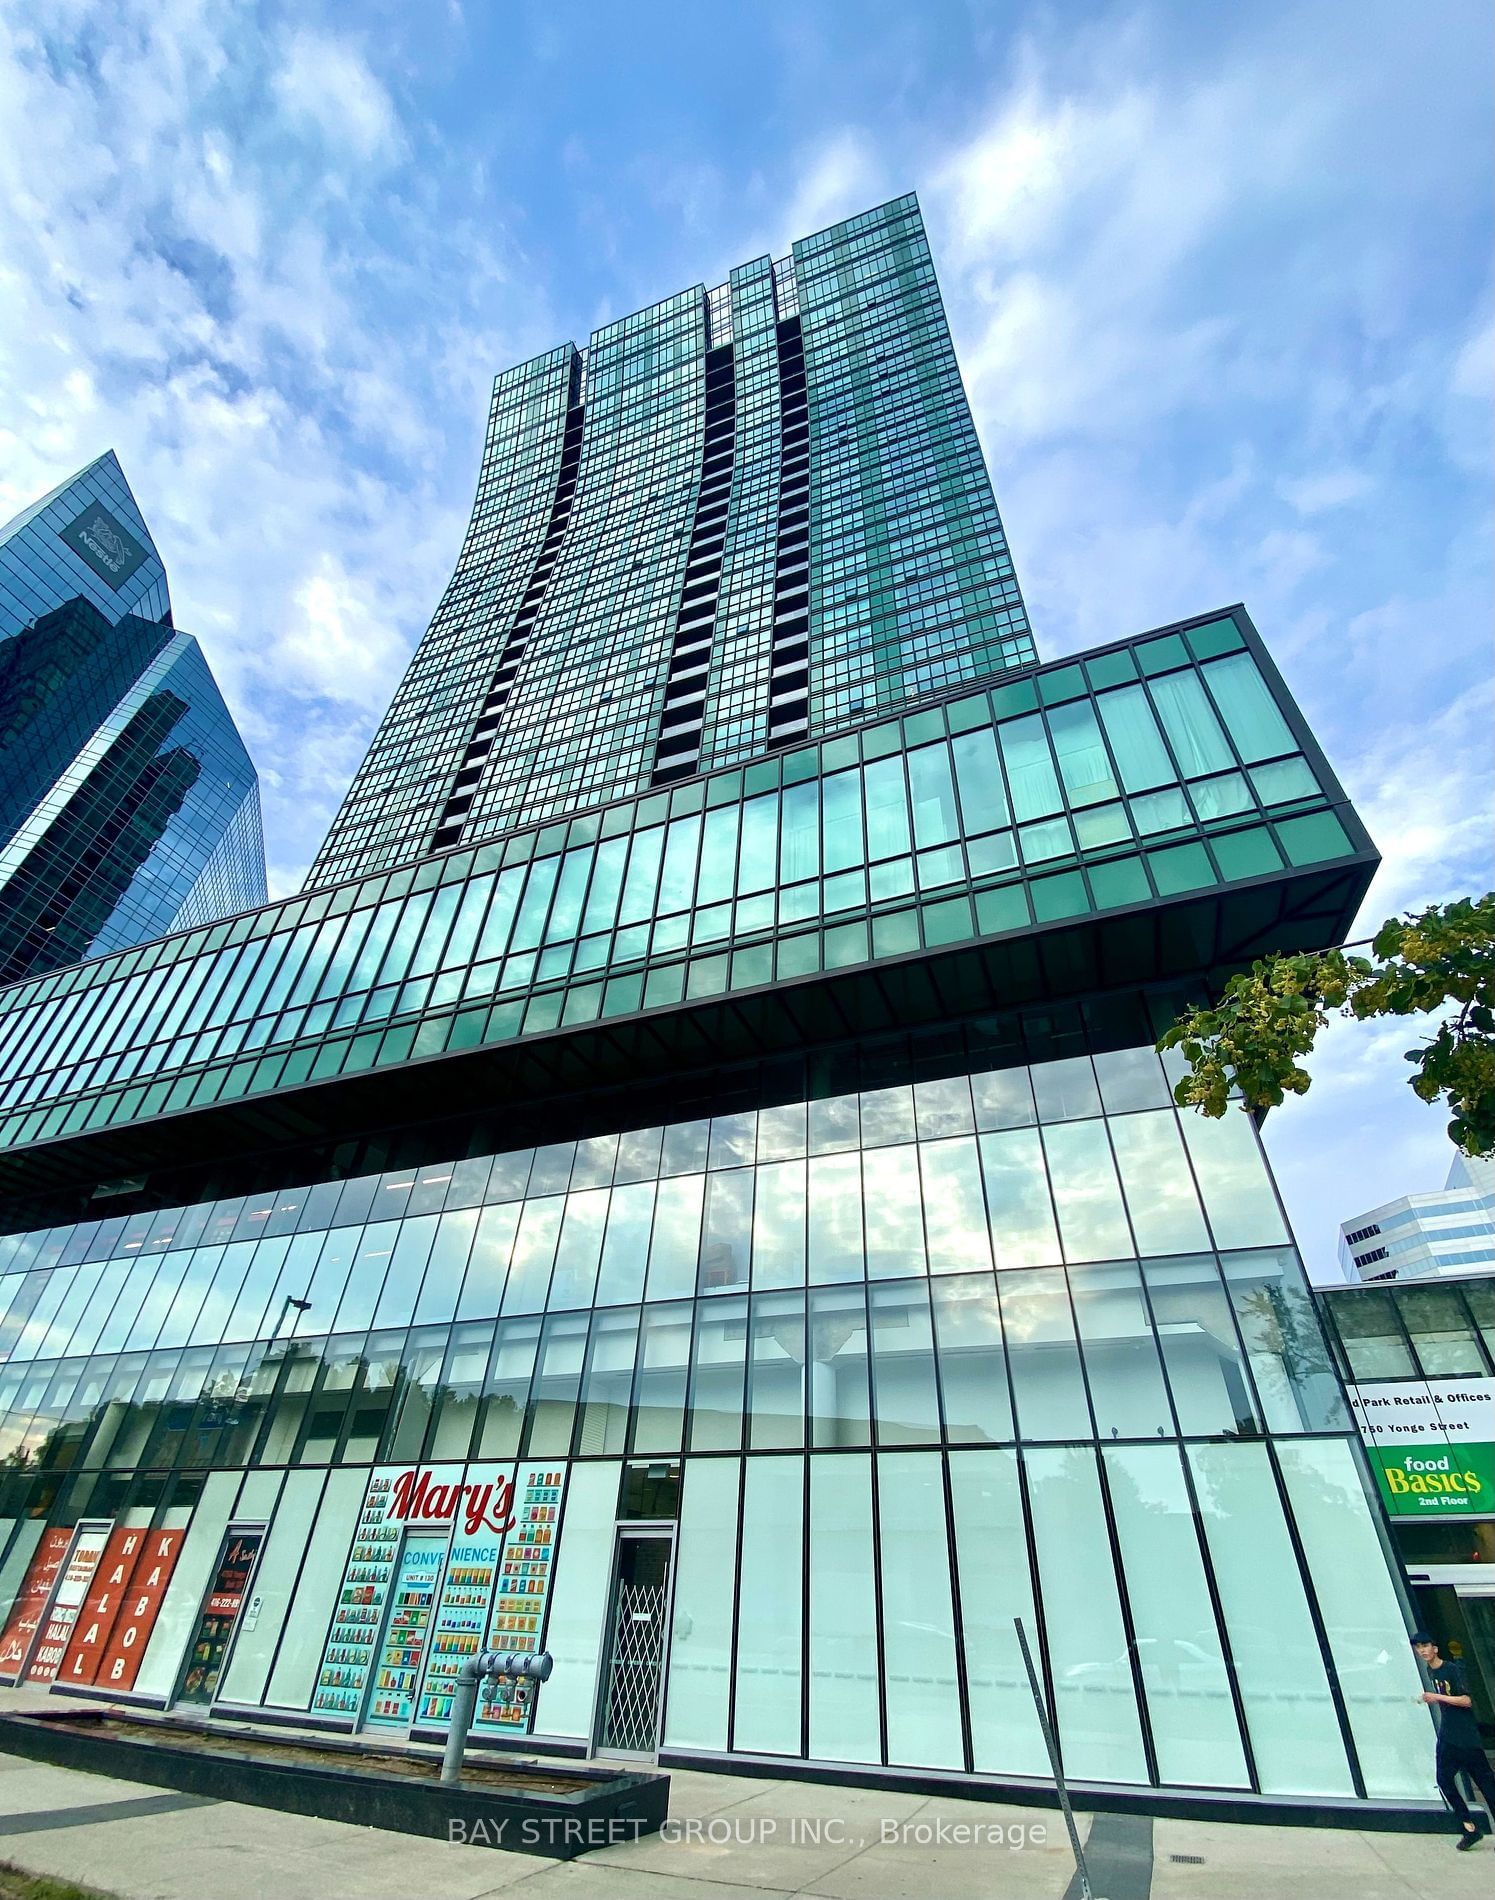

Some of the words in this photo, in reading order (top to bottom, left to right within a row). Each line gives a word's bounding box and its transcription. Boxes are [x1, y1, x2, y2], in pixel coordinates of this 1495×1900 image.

[1363, 1397, 1391, 1407] Park
[1394, 1395, 1431, 1406] Retail
[1434, 1394, 1444, 1404] &
[1447, 1393, 1492, 1403] Offices
[1388, 1424, 1425, 1434] Yonge
[1430, 1421, 1470, 1431] Street
[1404, 1456, 1449, 1472] food
[386, 1470, 517, 1536] Mary's
[1418, 1497, 1439, 1506] 2nd
[1441, 1496, 1469, 1506] Floor
[406, 1574, 419, 1582] UNIT
